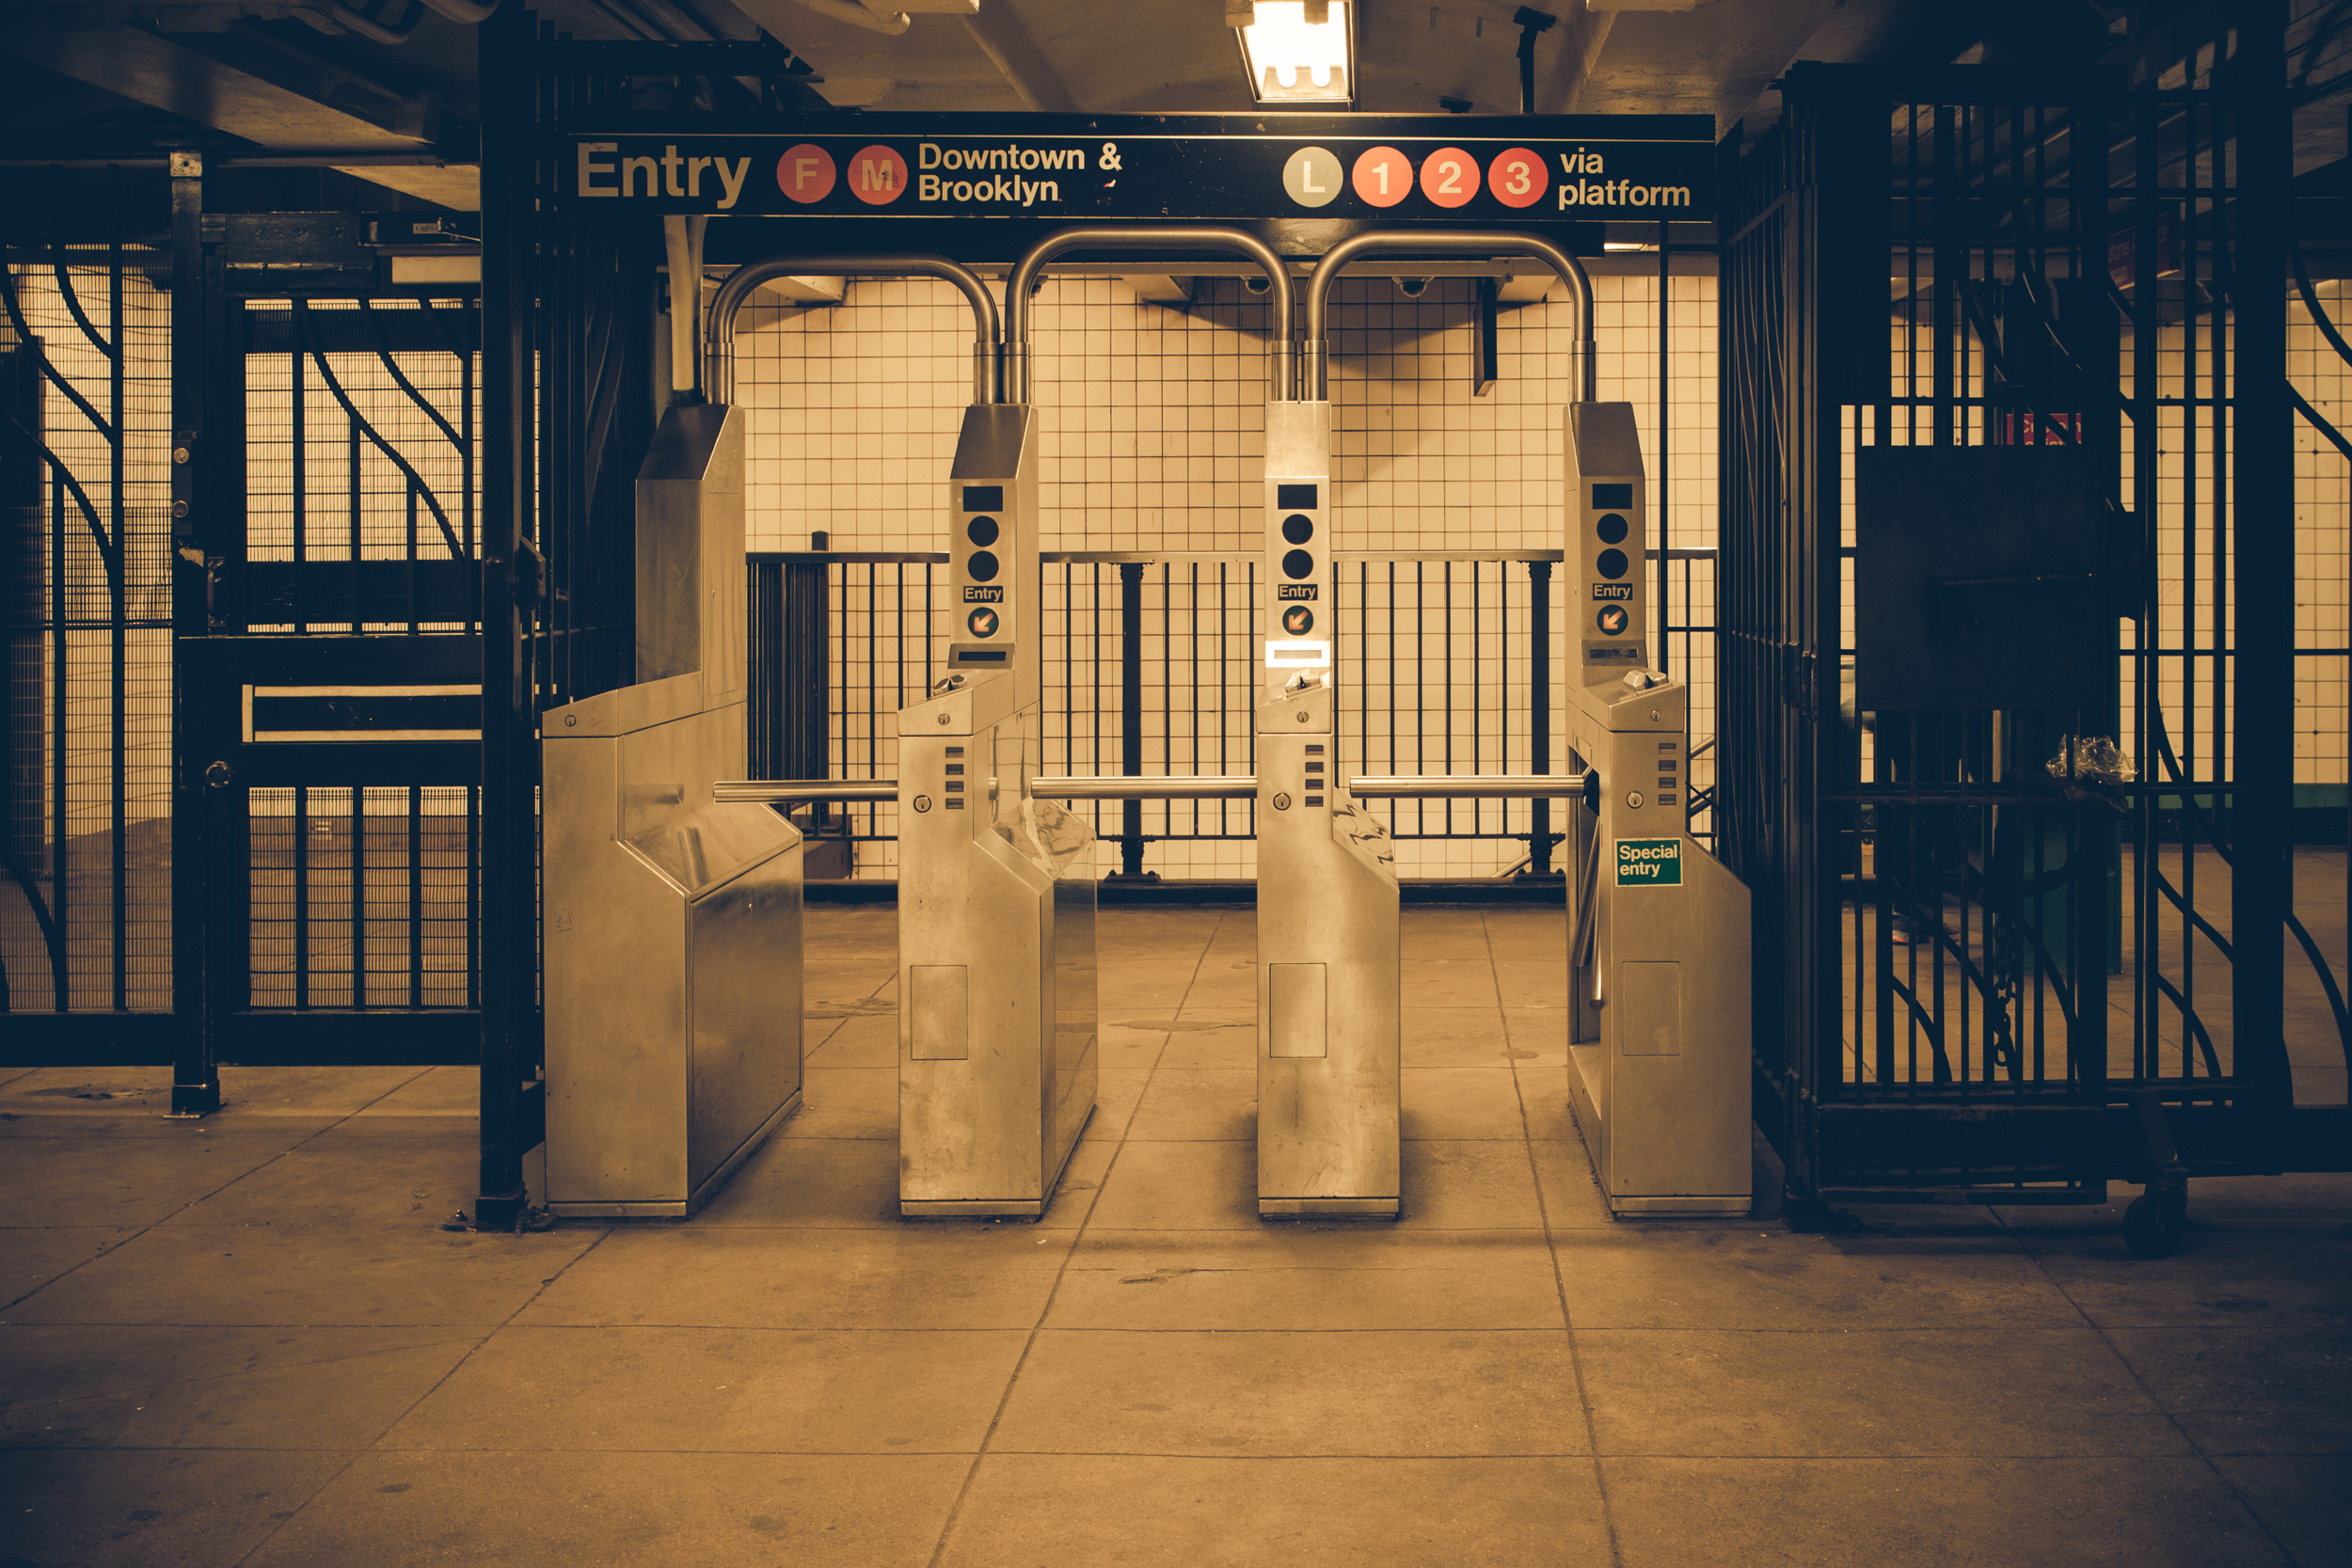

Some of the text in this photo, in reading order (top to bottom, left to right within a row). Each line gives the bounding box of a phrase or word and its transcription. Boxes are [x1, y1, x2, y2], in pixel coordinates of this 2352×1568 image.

[919, 142, 1122, 171] Downtown &
[1560, 147, 1603, 174] via
[578, 142, 752, 209] Entry
[795, 158, 893, 192] F M
[1303, 160, 1532, 195] L 1 2 3
[919, 174, 1058, 207] Brooklyn
[1558, 178, 1690, 211] platform
[964, 587, 1002, 603] Entry
[1279, 585, 1316, 601] Entry
[1594, 584, 1631, 600] Entry
[1619, 844, 1678, 860] Special
[1619, 860, 1661, 878] entry
